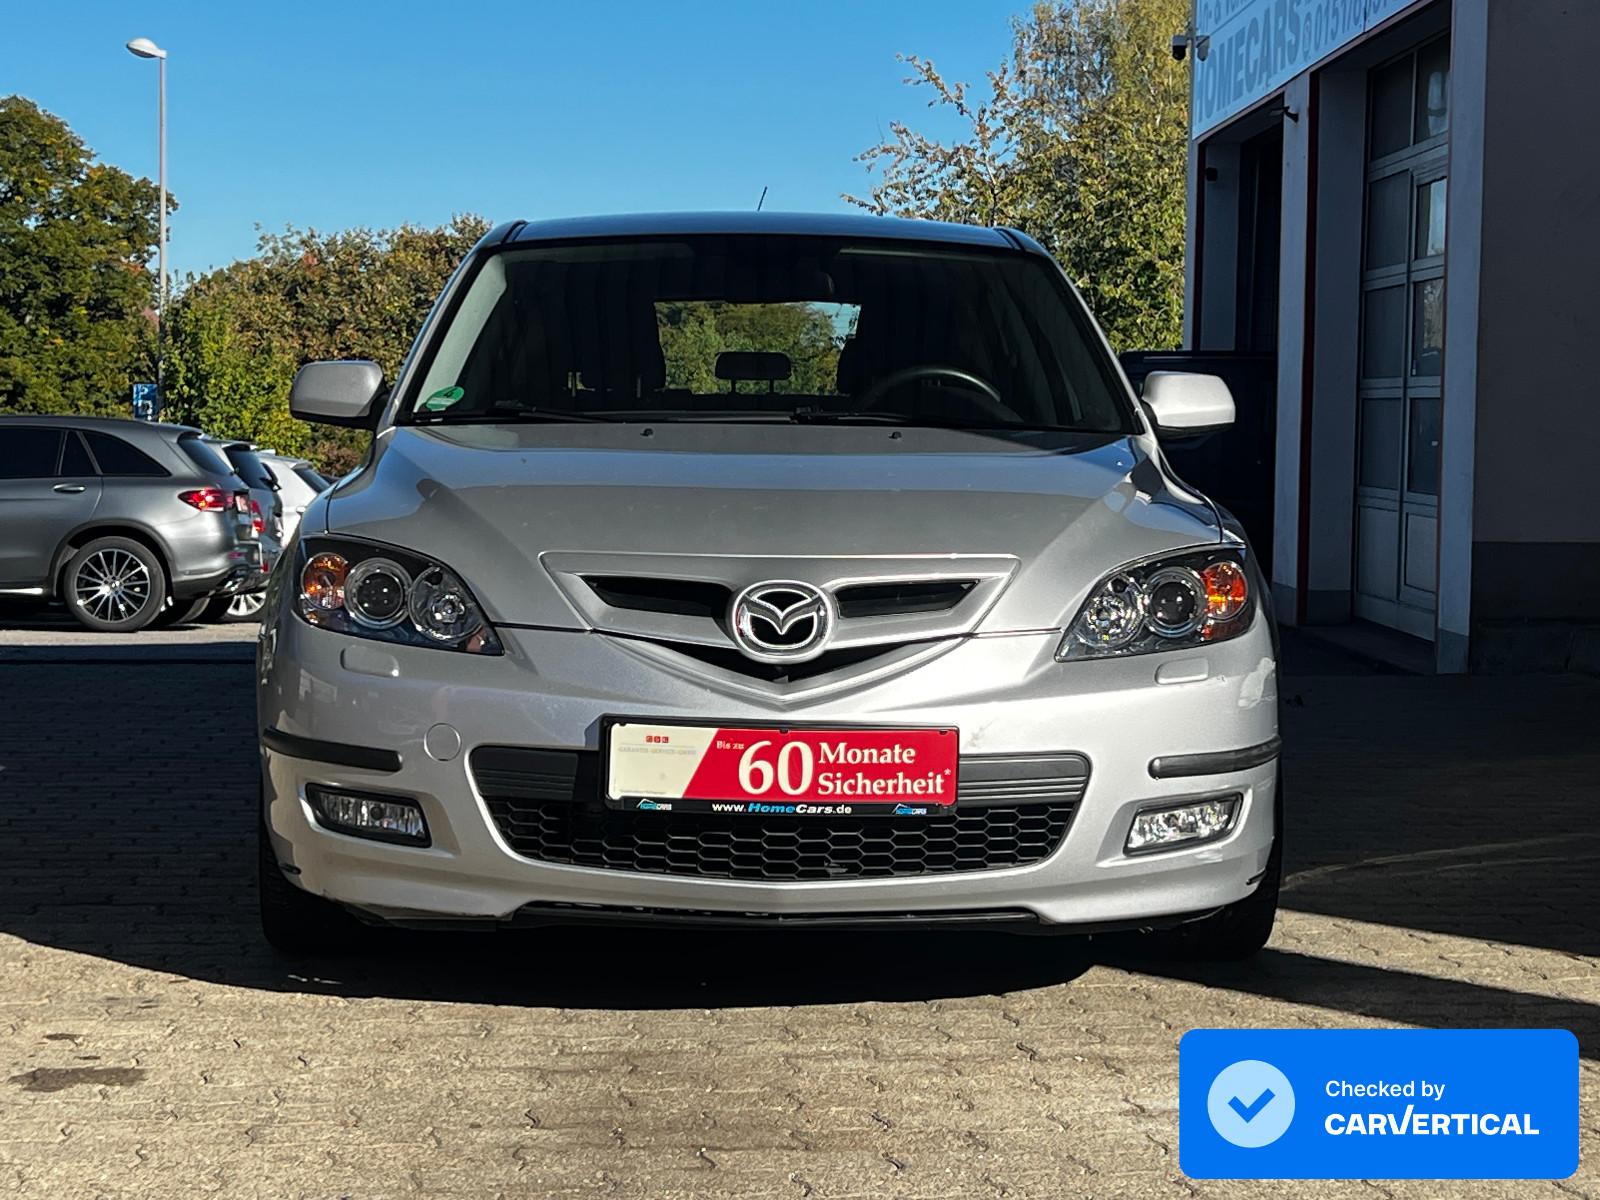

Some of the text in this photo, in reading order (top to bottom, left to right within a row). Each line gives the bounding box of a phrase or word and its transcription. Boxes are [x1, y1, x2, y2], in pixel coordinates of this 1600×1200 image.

[1193, 0, 1300, 125] HOMECARS
[716, 740, 731, 749] Bis
[818, 742, 916, 764] Monate
[738, 740, 814, 796] 60
[711, 803, 852, 815] www.HomeCars.de
